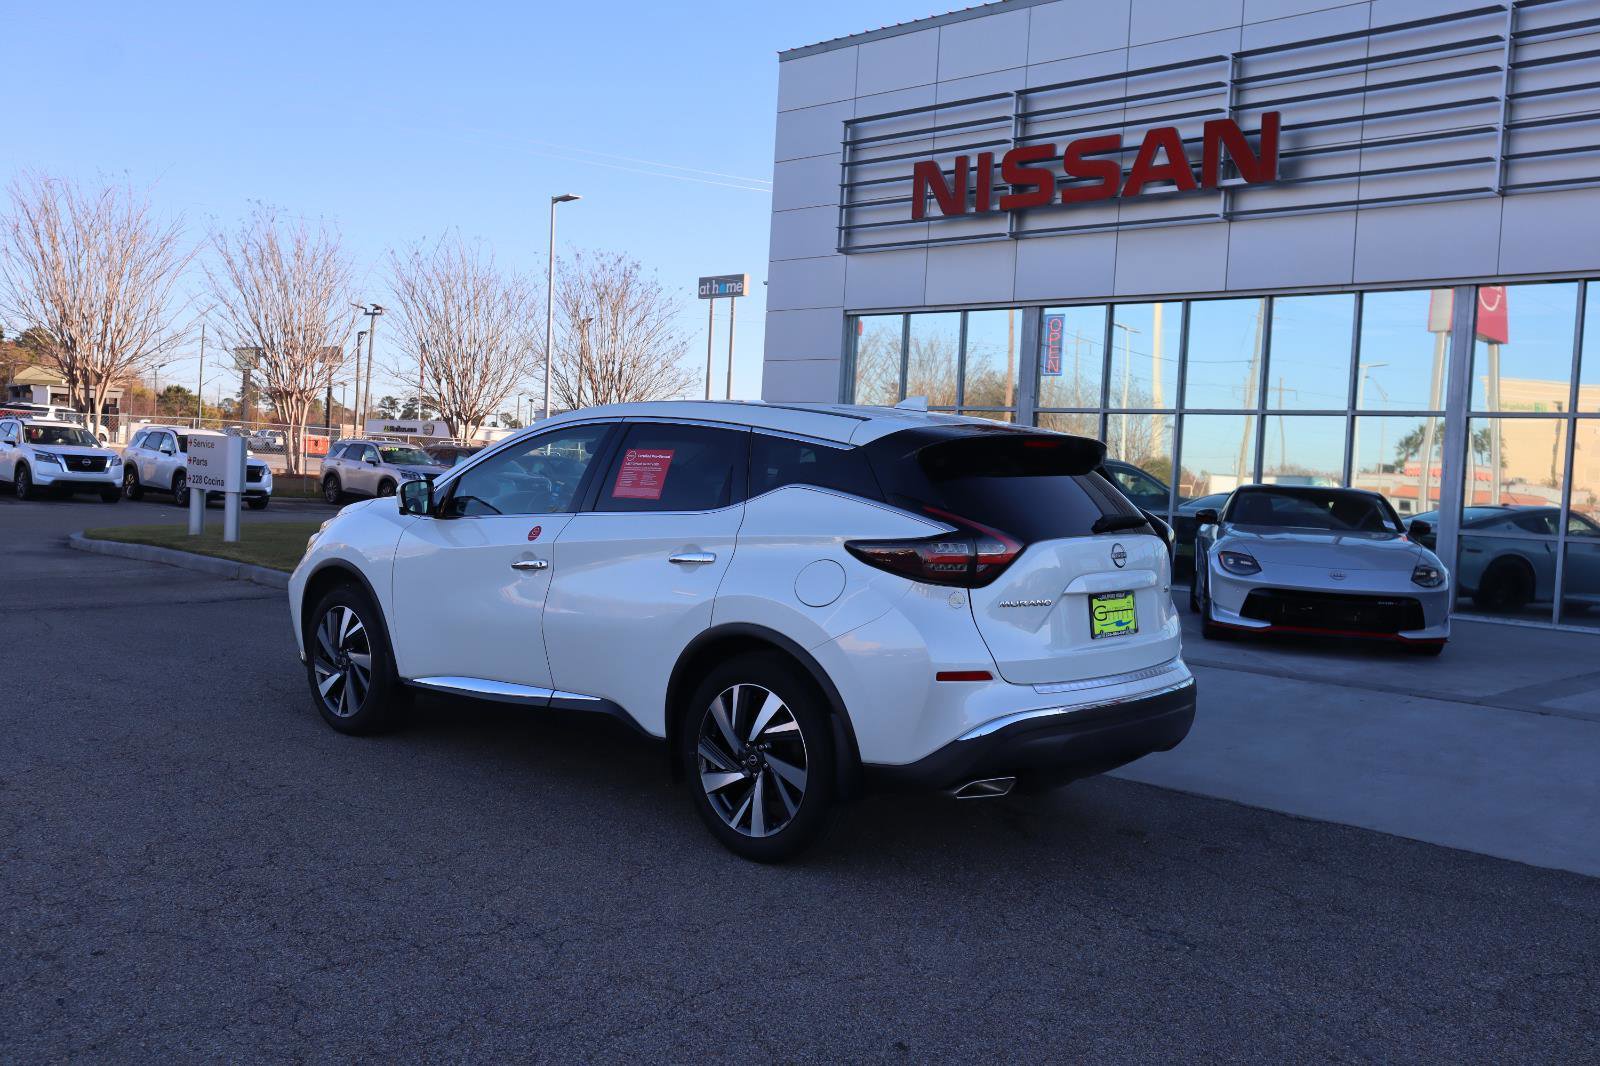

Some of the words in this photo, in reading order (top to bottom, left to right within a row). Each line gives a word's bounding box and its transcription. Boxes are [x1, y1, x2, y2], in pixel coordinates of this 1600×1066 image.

[911, 111, 1281, 220] NISSAN
[699, 282, 710, 295] at
[712, 280, 743, 294] home
[1047, 318, 1062, 373] OPEN
[192, 438, 215, 449] Service
[192, 456, 208, 466] Parts
[191, 474, 202, 484] 228
[203, 475, 225, 487] Cocina
[999, 599, 1052, 608] MURANO
